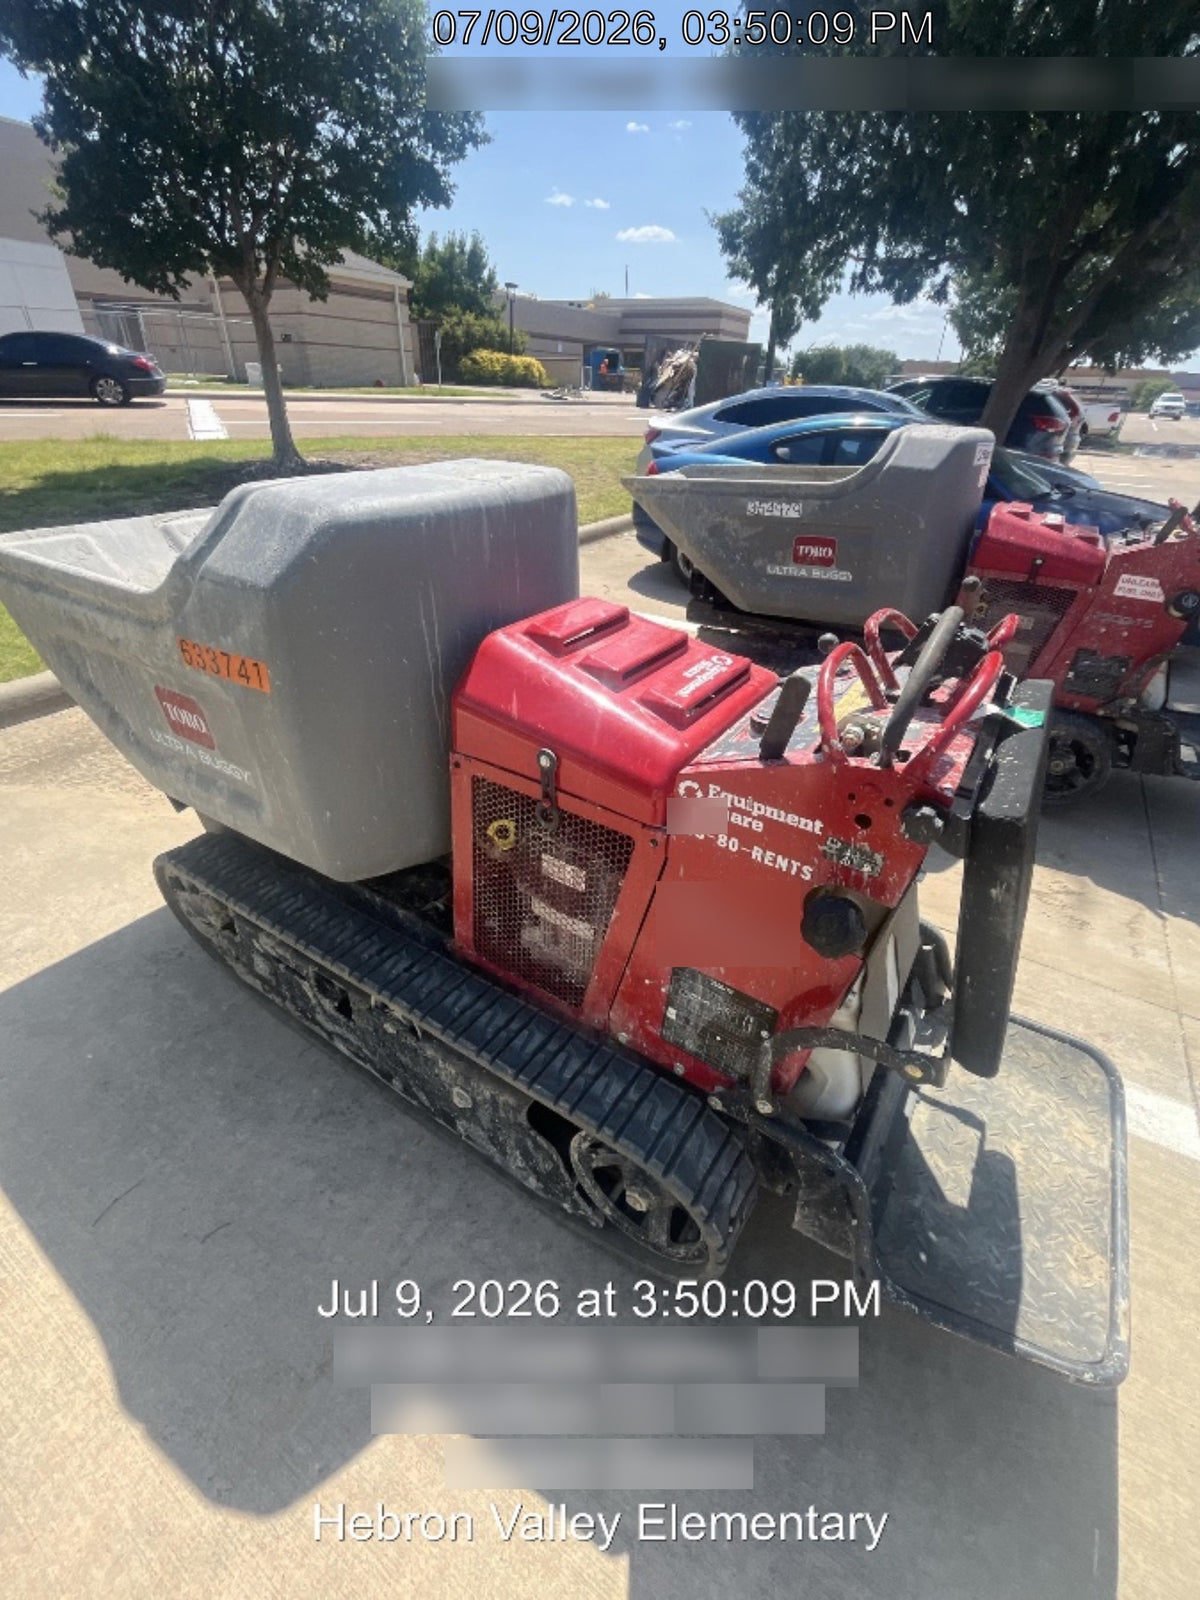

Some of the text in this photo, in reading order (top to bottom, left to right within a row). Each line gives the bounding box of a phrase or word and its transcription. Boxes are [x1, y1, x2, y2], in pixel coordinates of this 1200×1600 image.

[766, 565, 808, 577] ULTRA
[179, 638, 265, 690] 633741
[149, 727, 197, 759] ULTRA
[707, 783, 825, 837] Equipment
[727, 809, 765, 833] are
